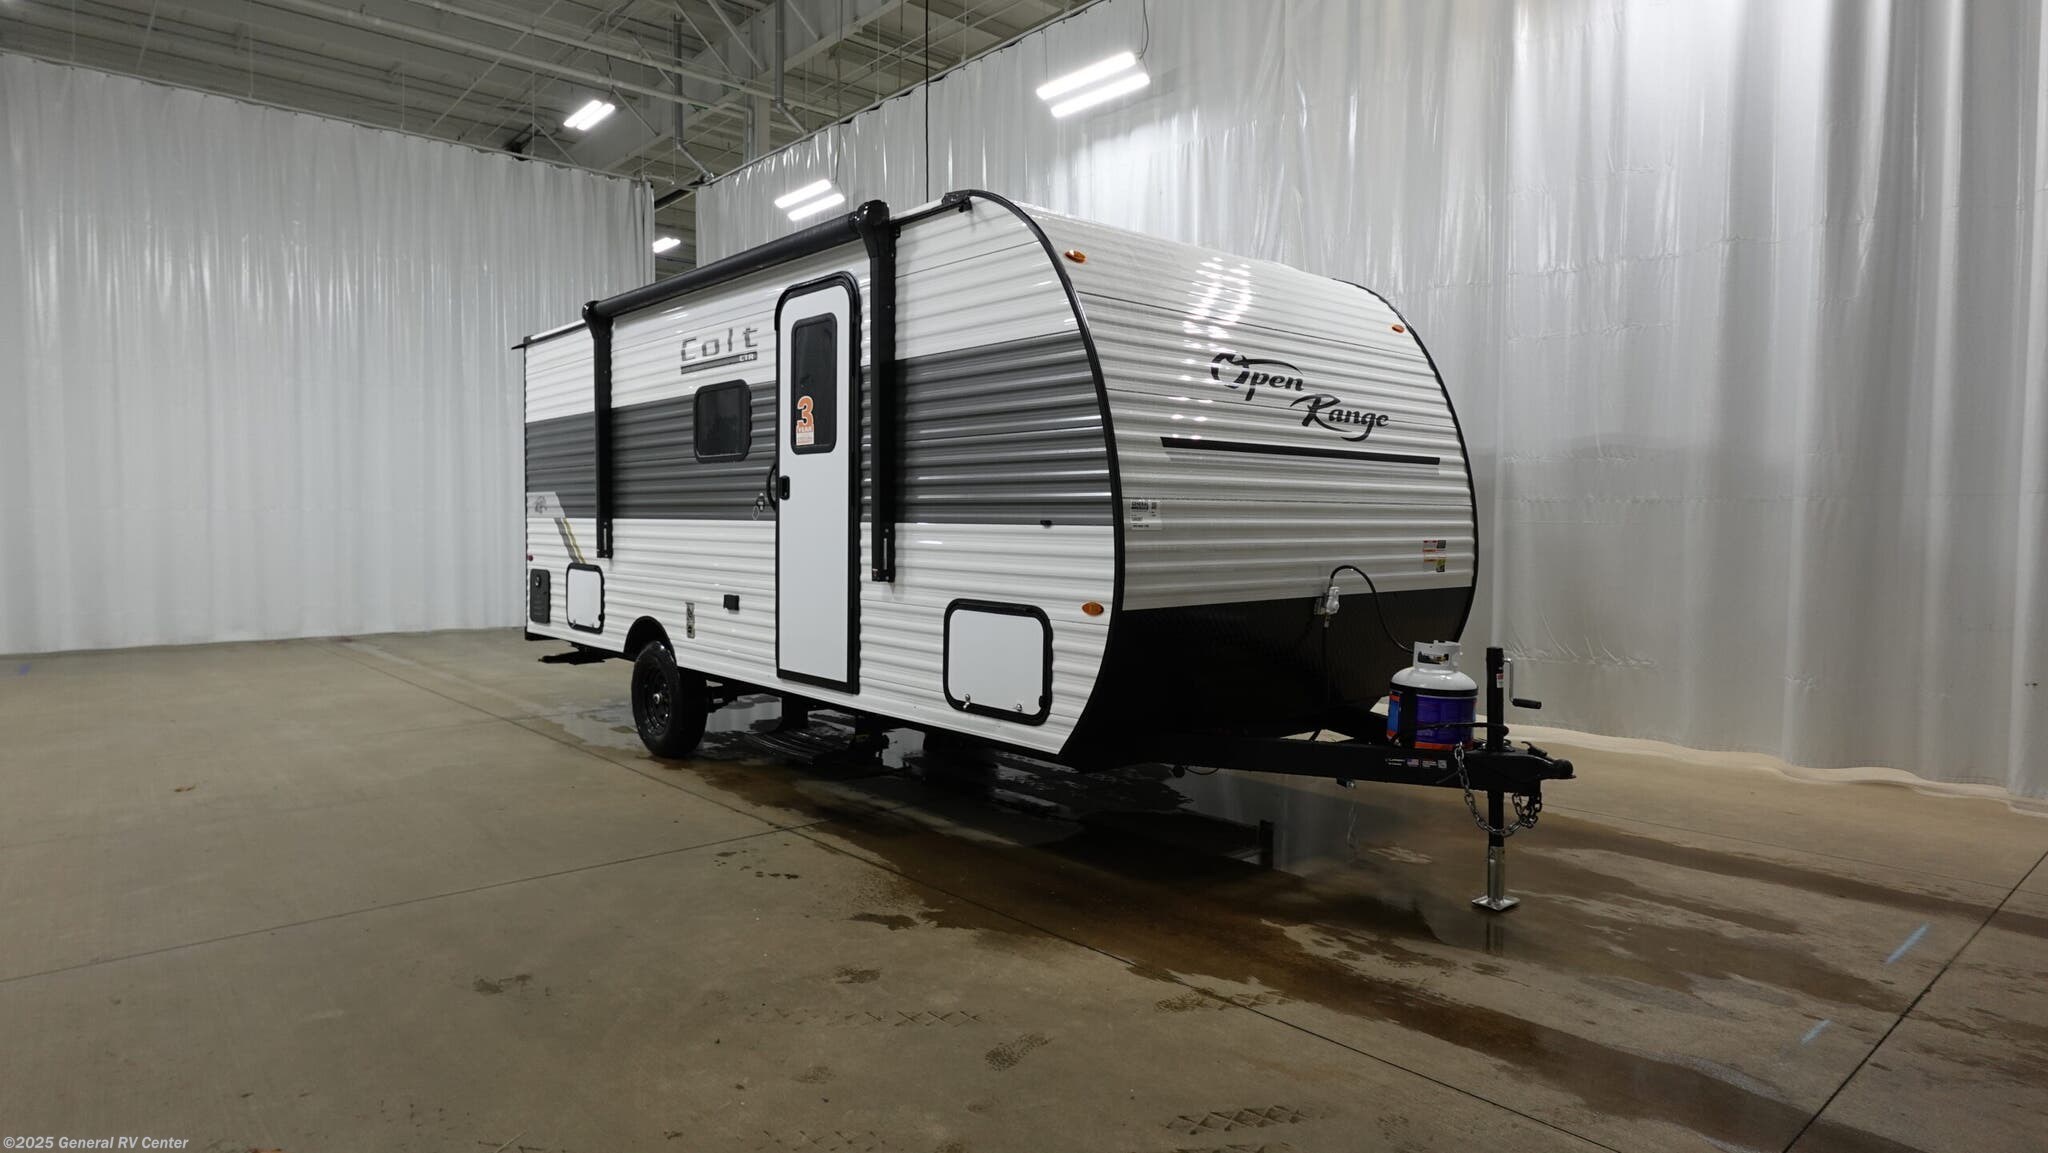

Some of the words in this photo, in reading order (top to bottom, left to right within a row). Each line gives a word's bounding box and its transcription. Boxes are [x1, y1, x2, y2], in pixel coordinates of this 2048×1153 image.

[681, 328, 758, 361] Colt
[1211, 353, 1304, 401] Open
[797, 396, 814, 426] 3
[1290, 393, 1389, 442] Range
